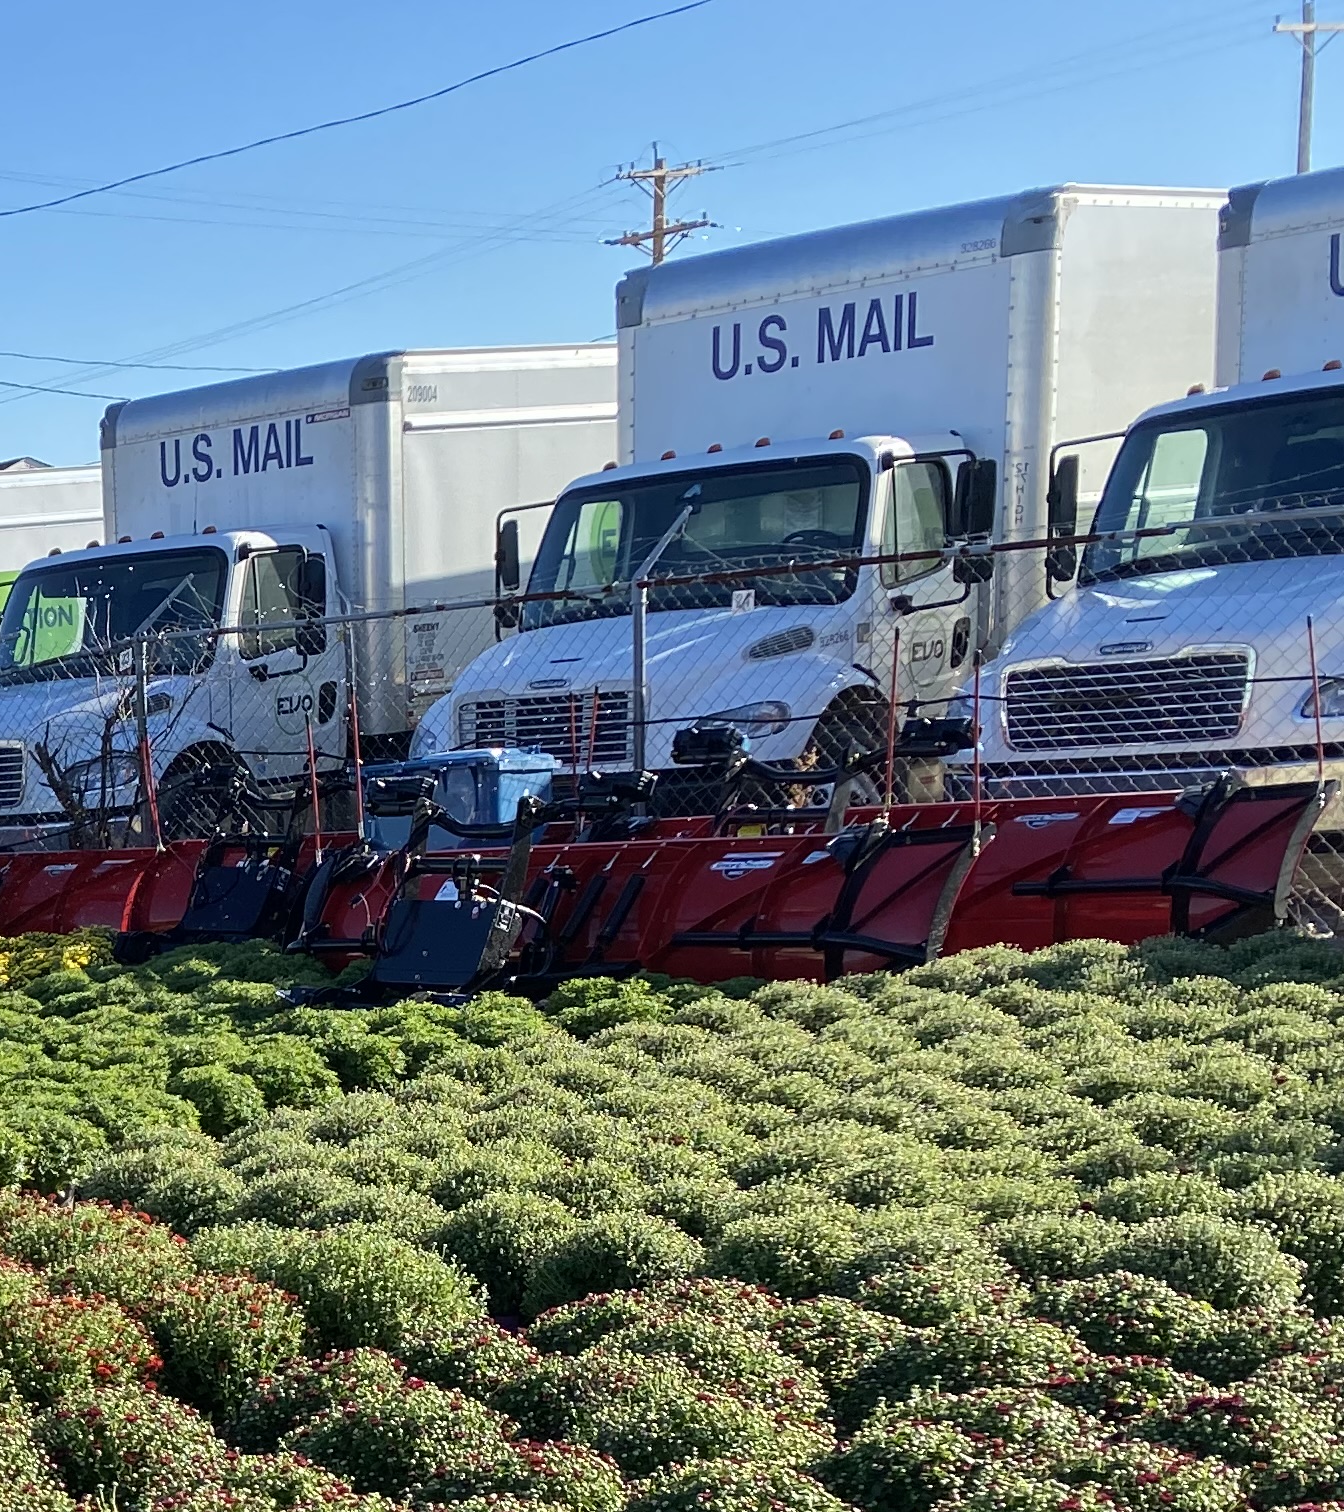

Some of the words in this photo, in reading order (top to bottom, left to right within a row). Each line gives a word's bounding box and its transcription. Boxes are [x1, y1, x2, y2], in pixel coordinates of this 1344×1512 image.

[712, 314, 800, 381] U.S.
[816, 291, 935, 364] MAIL
[160, 433, 223, 487] U.S.
[233, 418, 314, 477] MAIL
